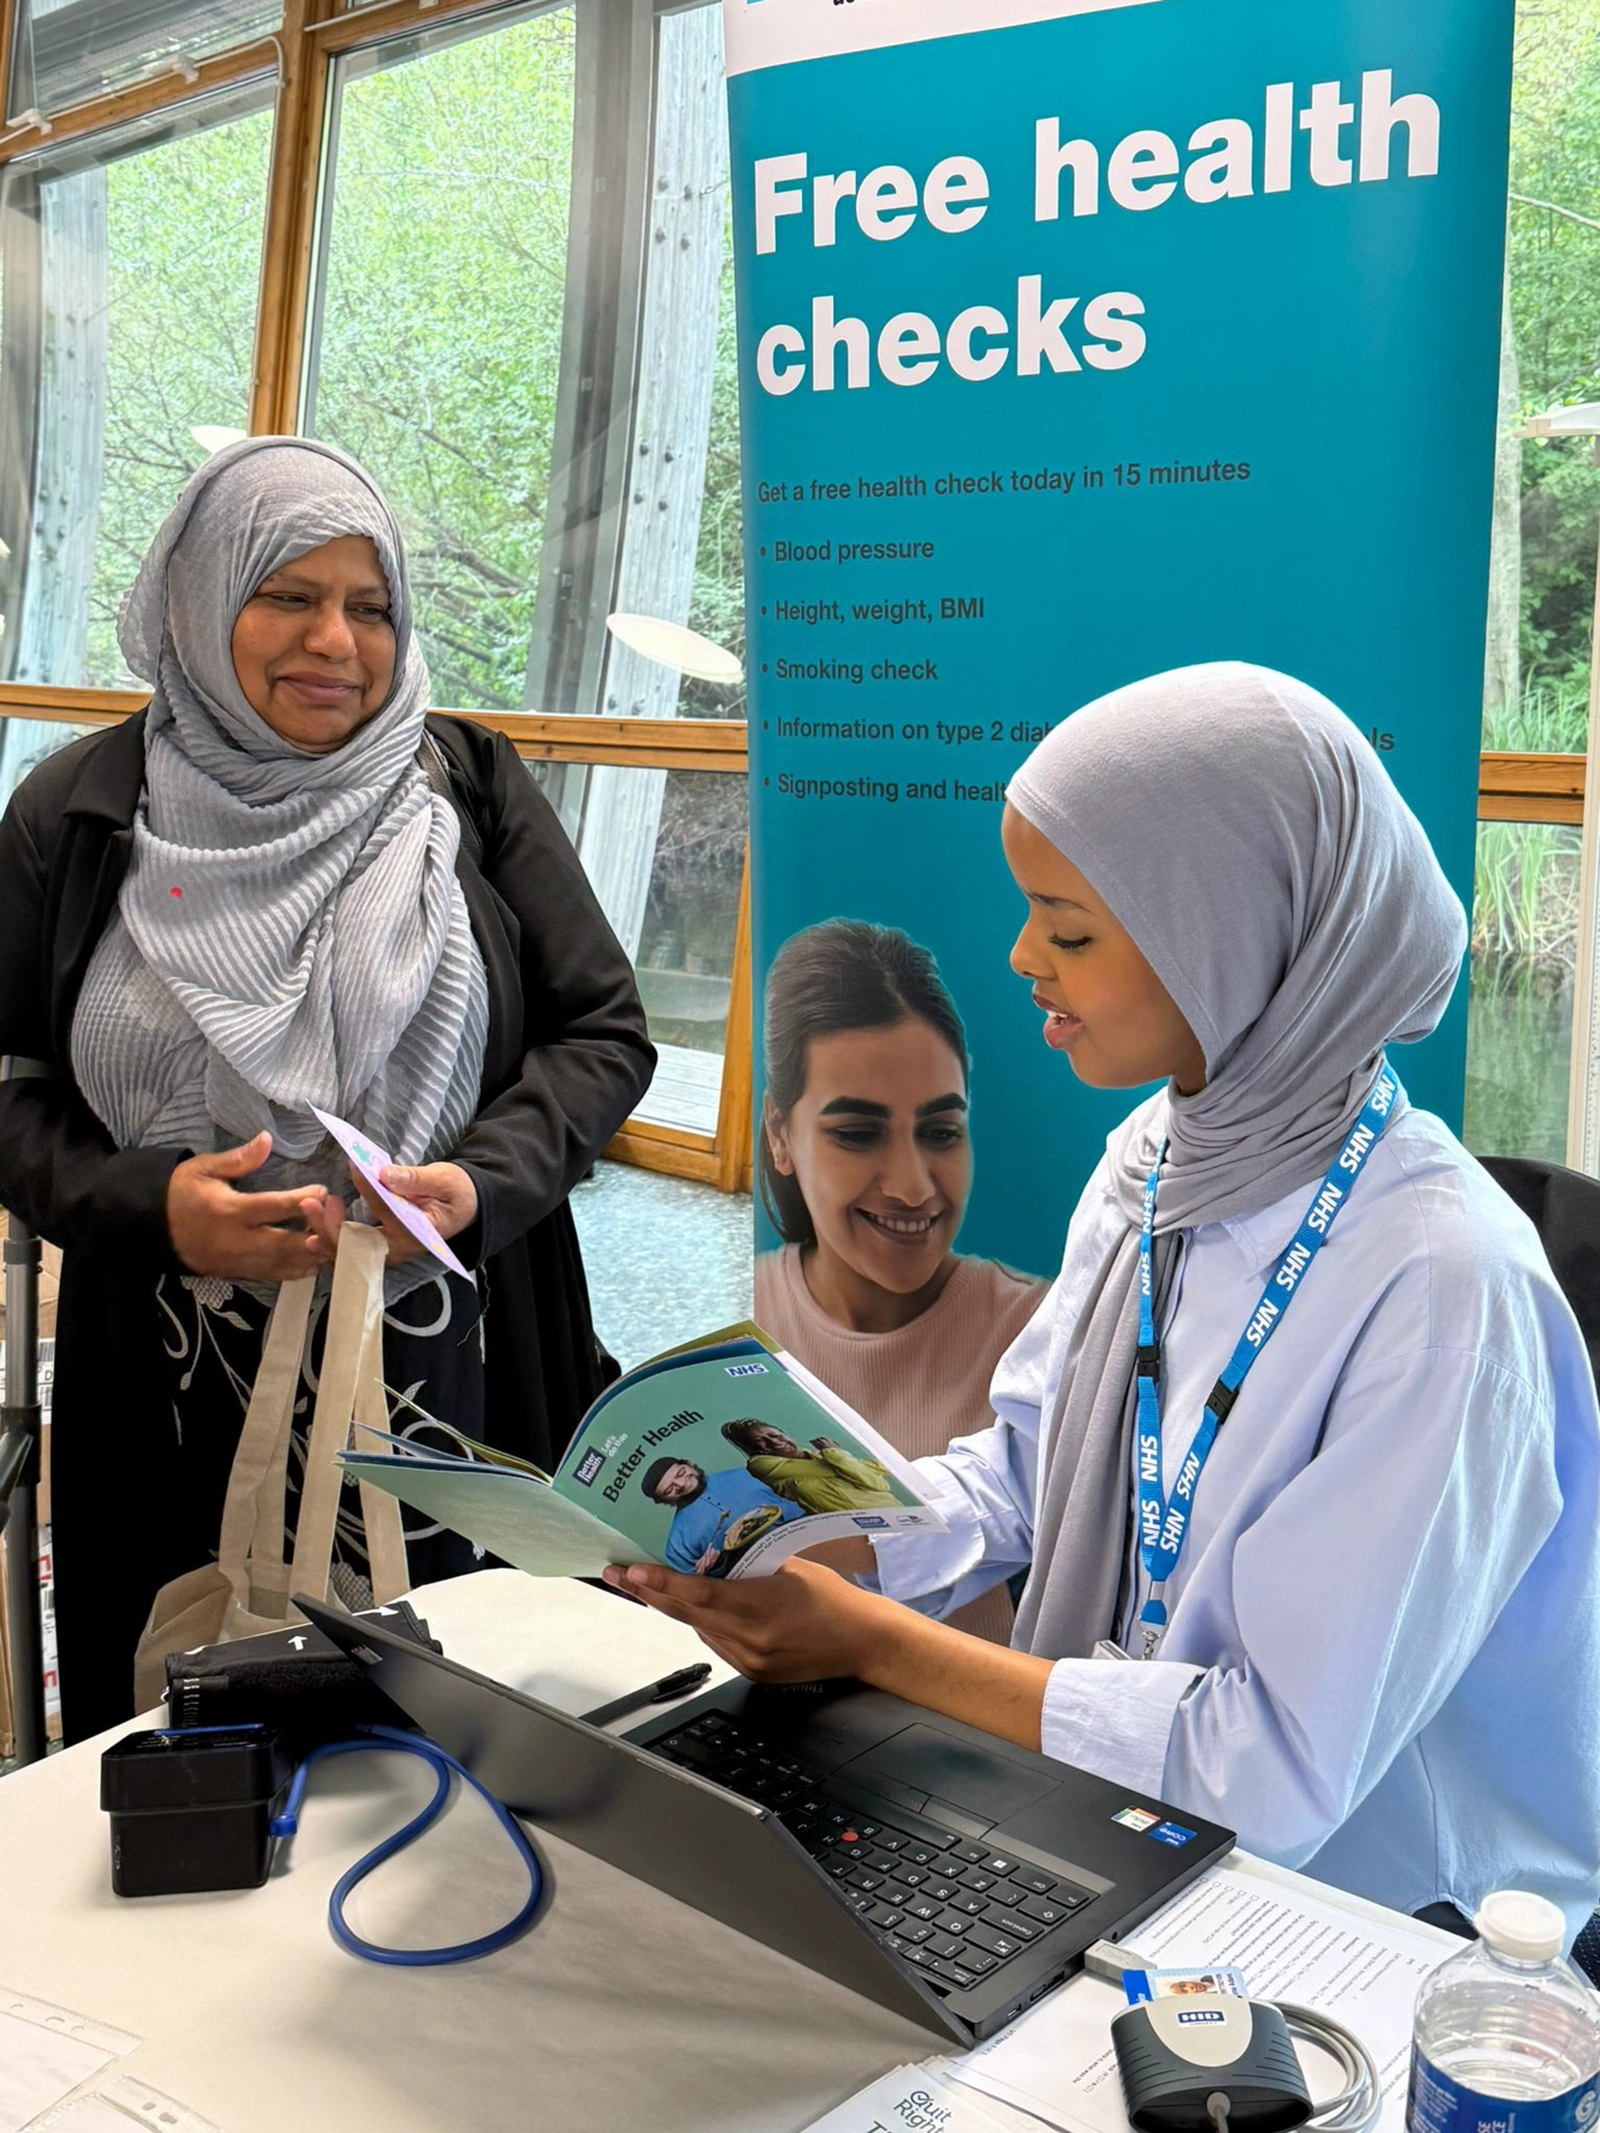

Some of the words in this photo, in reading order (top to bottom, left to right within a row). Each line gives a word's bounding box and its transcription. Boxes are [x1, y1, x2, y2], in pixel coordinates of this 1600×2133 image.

[755, 152, 989, 255] Free
[1035, 69, 1440, 221] health
[757, 275, 1146, 395] checks
[758, 481, 788, 504] Get
[792, 486, 804, 502] a
[810, 477, 851, 501] free
[858, 474, 927, 499] health
[934, 470, 1004, 495] check
[1010, 467, 1076, 495] today
[1083, 465, 1104, 488] in
[1113, 463, 1141, 487] 15
[1149, 459, 1251, 485] minutes
[775, 539, 831, 562] Blood
[837, 541, 935, 565] pressure
[775, 599, 845, 625] Height,
[852, 599, 933, 624] weight,
[940, 598, 985, 620] BMI
[776, 657, 864, 684] Smoking
[870, 658, 939, 681] check
[777, 716, 895, 740] Information
[901, 723, 930, 740] on
[935, 720, 985, 746] type
[990, 720, 1004, 742] 2
[1367, 727, 1395, 751] ls
[778, 773, 899, 803] Signposting
[905, 778, 948, 801] and
[1371, 1074, 1397, 1117] NHS
[1339, 1123, 1375, 1174] NHS
[1308, 1182, 1343, 1233] NHS
[1141, 1250, 1151, 1296] NHS
[1276, 1241, 1311, 1291] NHS
[1246, 1298, 1279, 1347] NHS
[728, 1363, 766, 1377] NHS
[602, 1444, 648, 1503] Better
[642, 1409, 705, 1448] Health
[1141, 1434, 1158, 1482] NHS
[1177, 1452, 1200, 1501] NHS
[1142, 1499, 1161, 1547] NHS
[1160, 1507, 1186, 1555] NHS
[1181, 2011, 1221, 2021] HID
[910, 2090, 952, 2123] Quit
